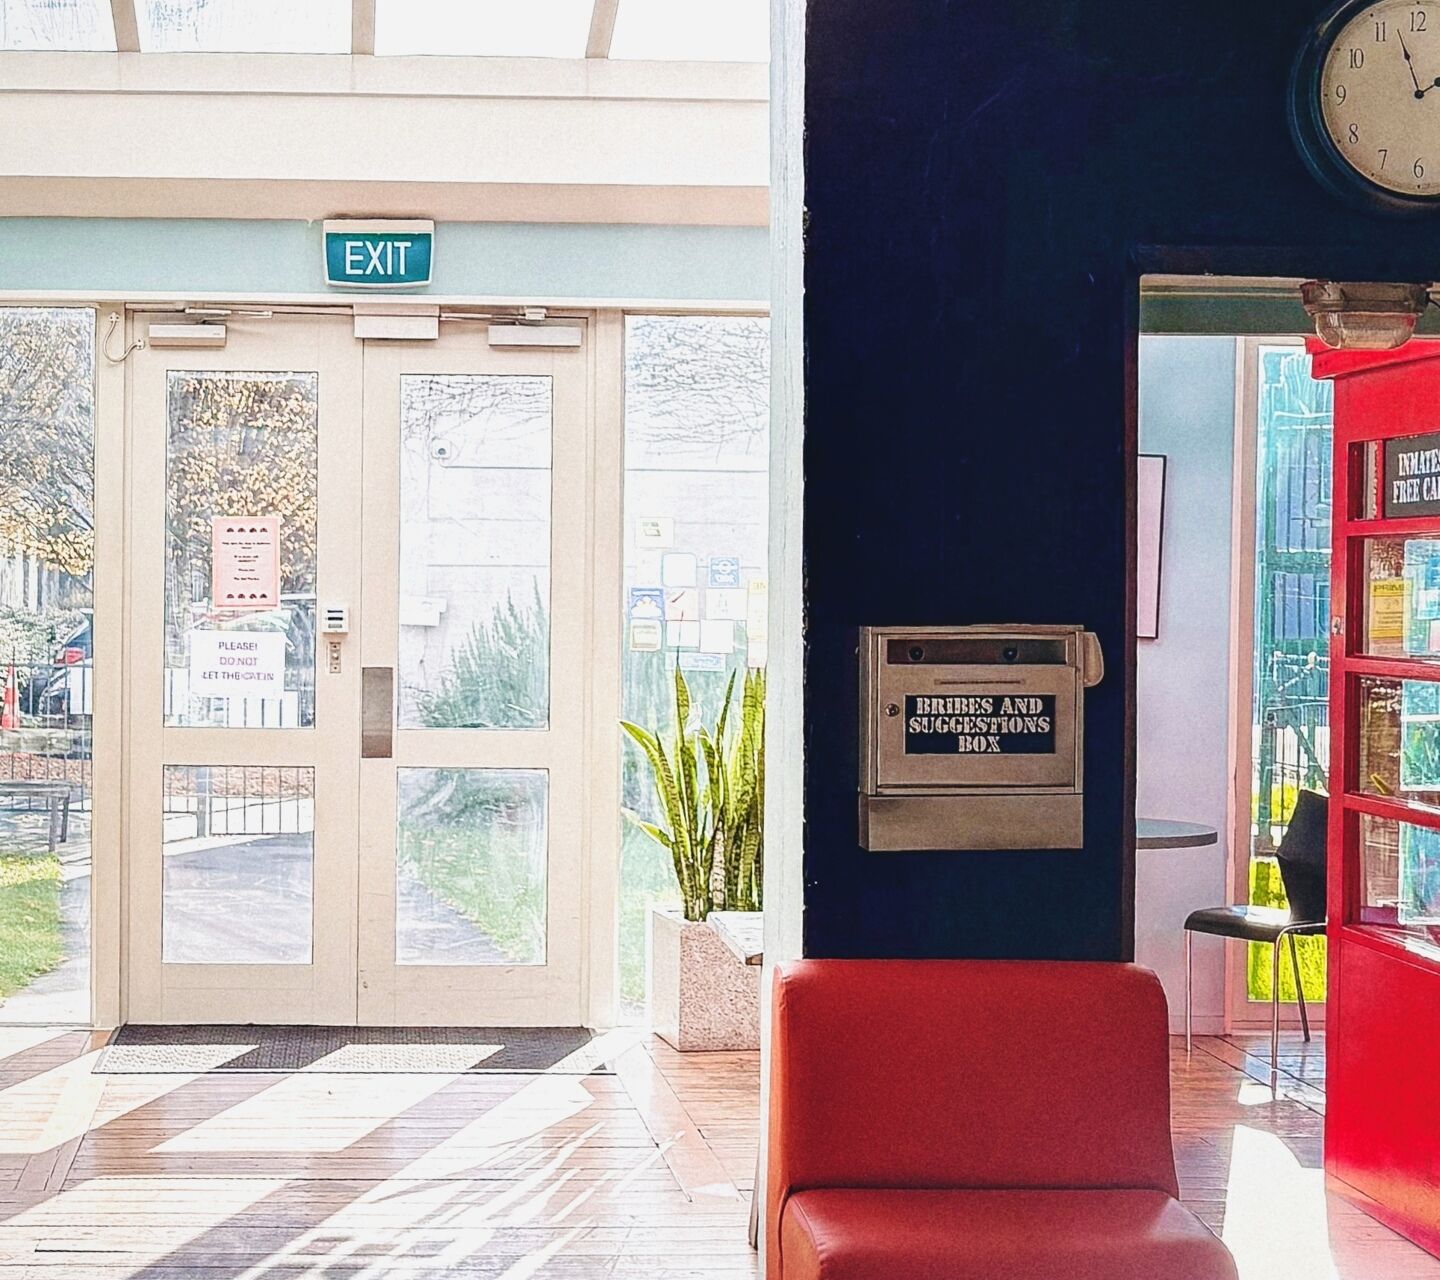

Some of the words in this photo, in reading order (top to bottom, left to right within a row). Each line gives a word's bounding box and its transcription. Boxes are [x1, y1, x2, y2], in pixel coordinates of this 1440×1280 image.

[1375, 21, 1387, 42] 11
[1409, 11, 1427, 33] 12
[1349, 48, 1365, 70] 10
[1335, 84, 1348, 106] 9
[1348, 123, 1360, 144] 8
[1377, 149, 1388, 170] 7
[1412, 157, 1425, 179] 6
[345, 240, 412, 275] EXIT
[1391, 479, 1421, 504] FREE
[218, 641, 259, 651] PLEASE!
[219, 657, 236, 666] DO
[236, 657, 258, 666] NOT
[202, 671, 219, 680] LET
[222, 671, 241, 680] THE
[916, 697, 994, 715] BRIBES
[1000, 697, 1044, 715] AND
[909, 716, 1051, 734] SUGGESTIONS
[958, 735, 1001, 752] BOX
